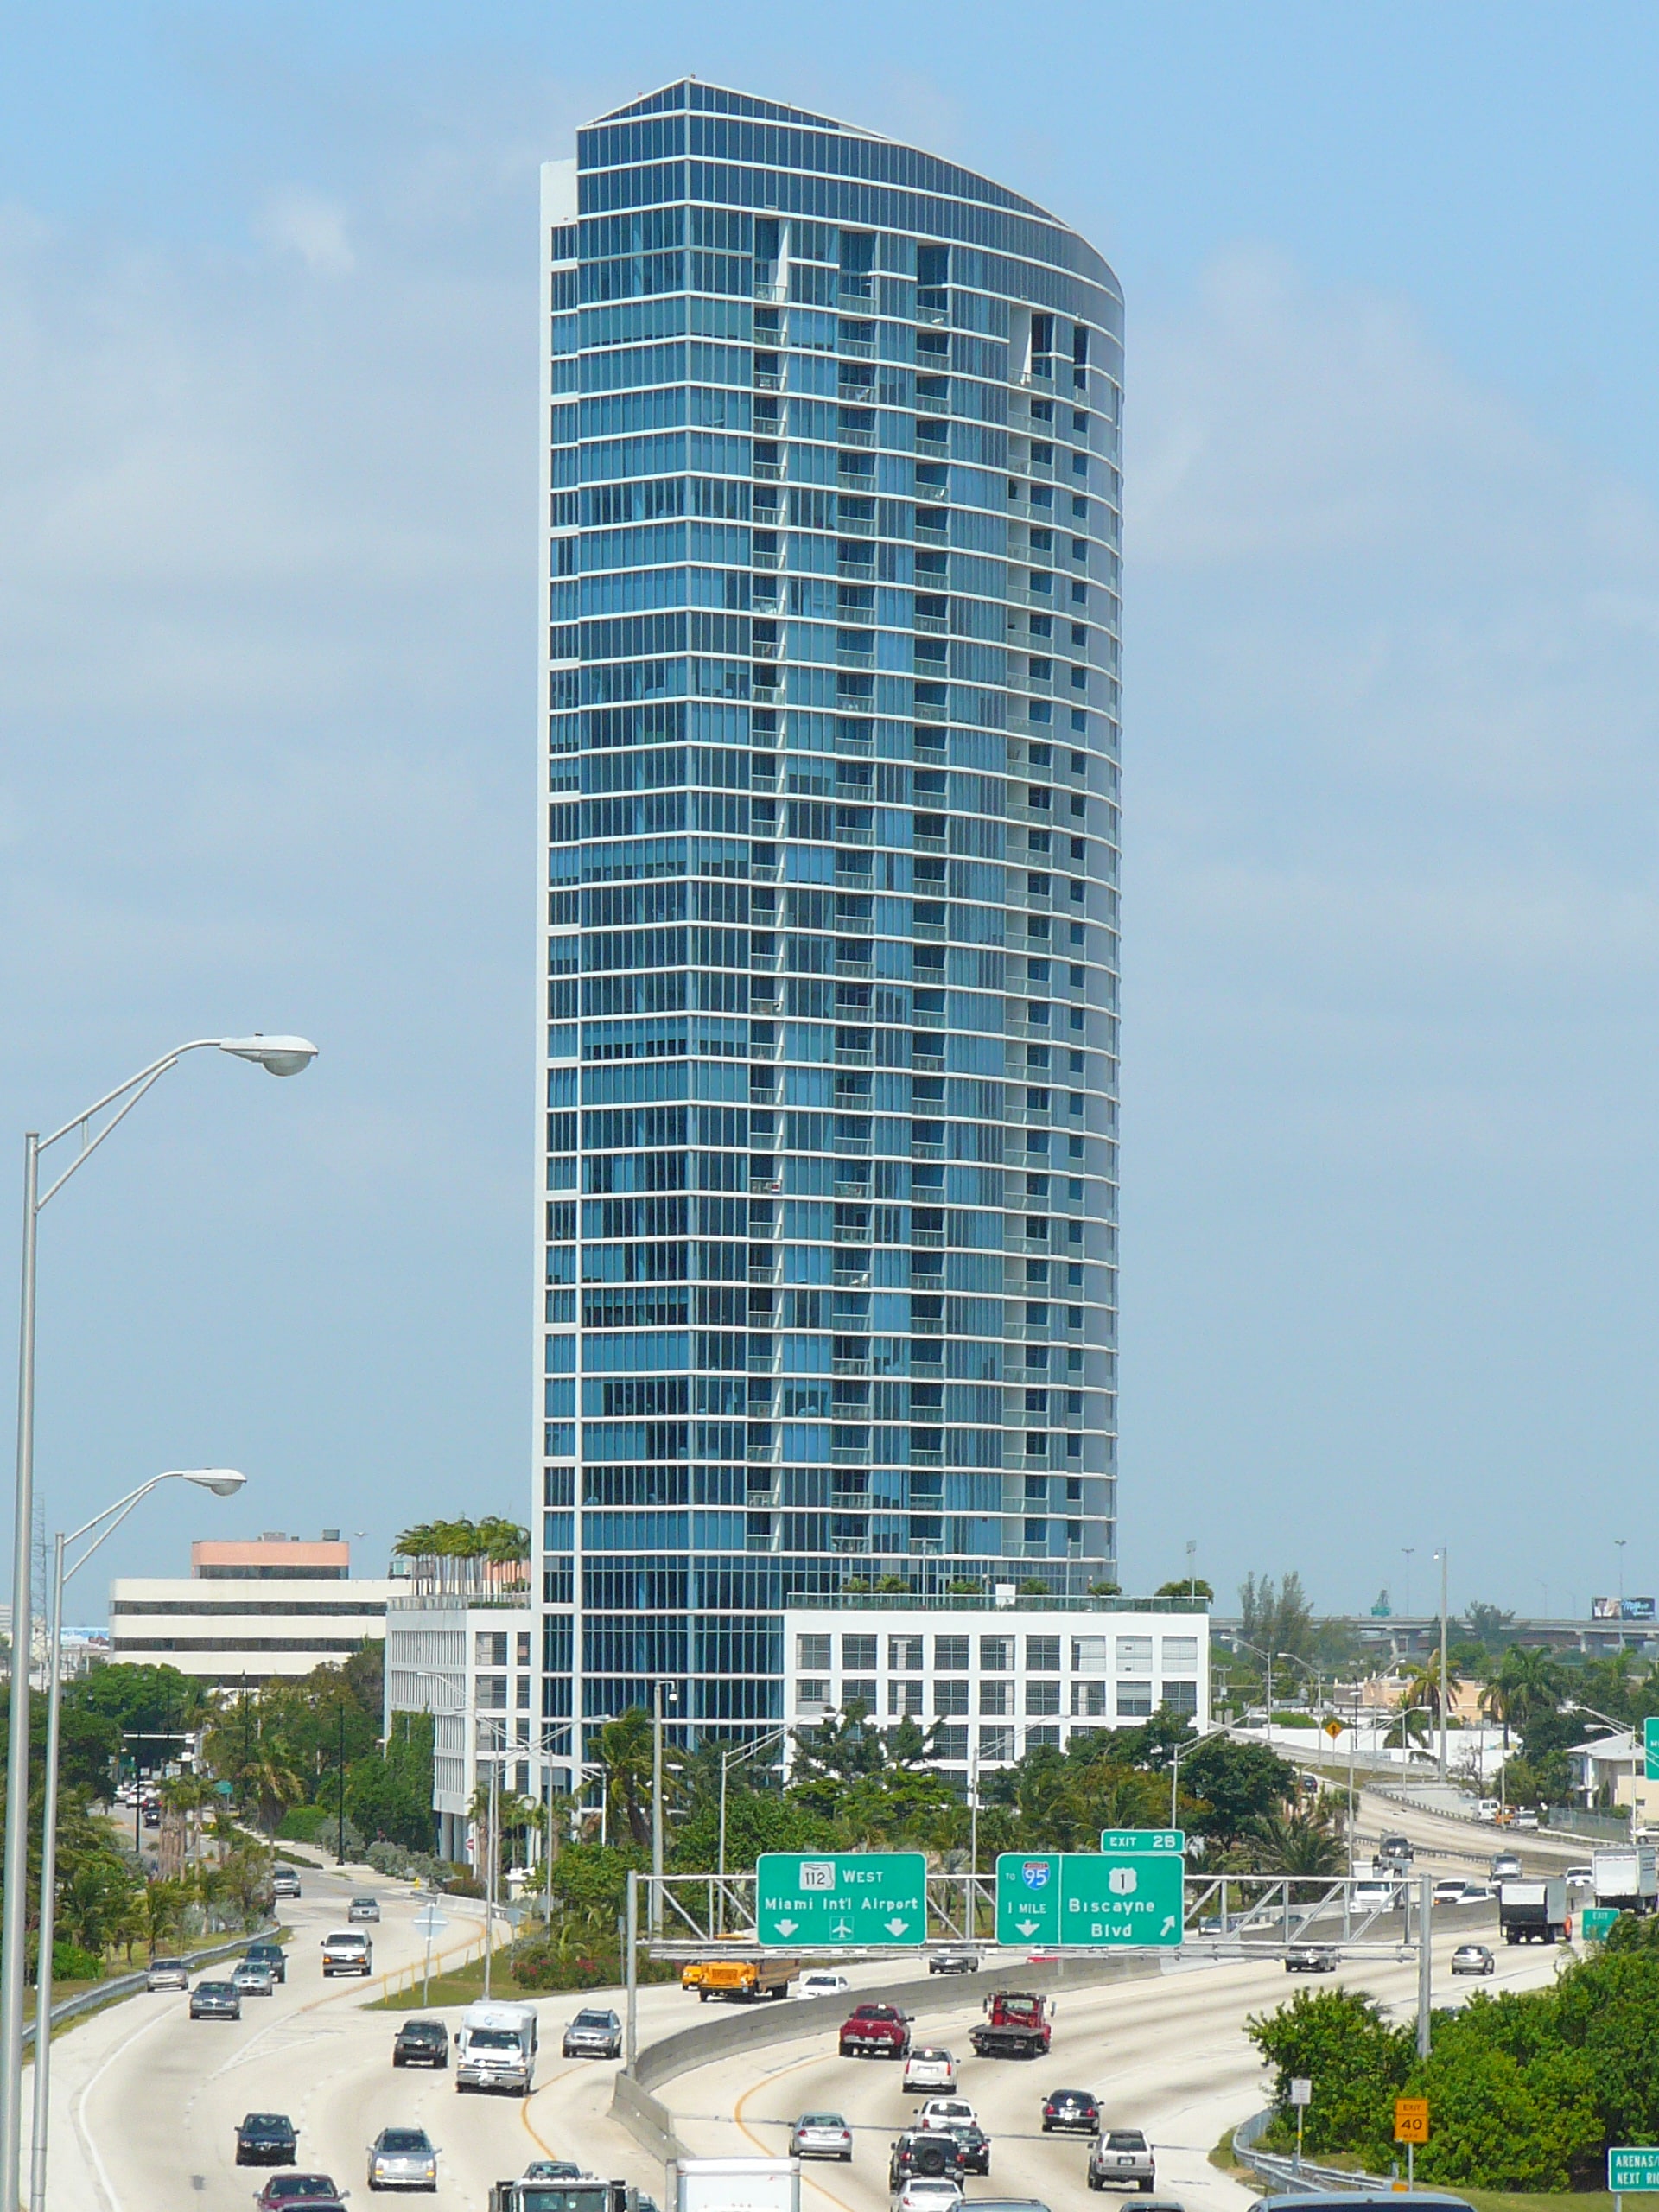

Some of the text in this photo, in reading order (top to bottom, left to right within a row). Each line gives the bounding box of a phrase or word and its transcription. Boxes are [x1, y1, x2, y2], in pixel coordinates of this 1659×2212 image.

[1109, 1835, 1176, 1848] EXIT 2B
[804, 1870, 884, 1885] 112 WEST
[1005, 1869, 1047, 1885] TO 95
[1120, 1873, 1125, 1890] 1
[764, 1897, 918, 1912] Miami Int'l Airport
[1007, 1902, 1047, 1914] 1 MILE
[1068, 1897, 1155, 1916] Biscayne
[1090, 1923, 1133, 1937] Blvd
[1403, 2103, 1421, 2112] EXIT
[1401, 2118, 1423, 2131] 40
[1616, 2155, 1659, 2168] ARENAS/
[1617, 2171, 1640, 2184] NEXT
